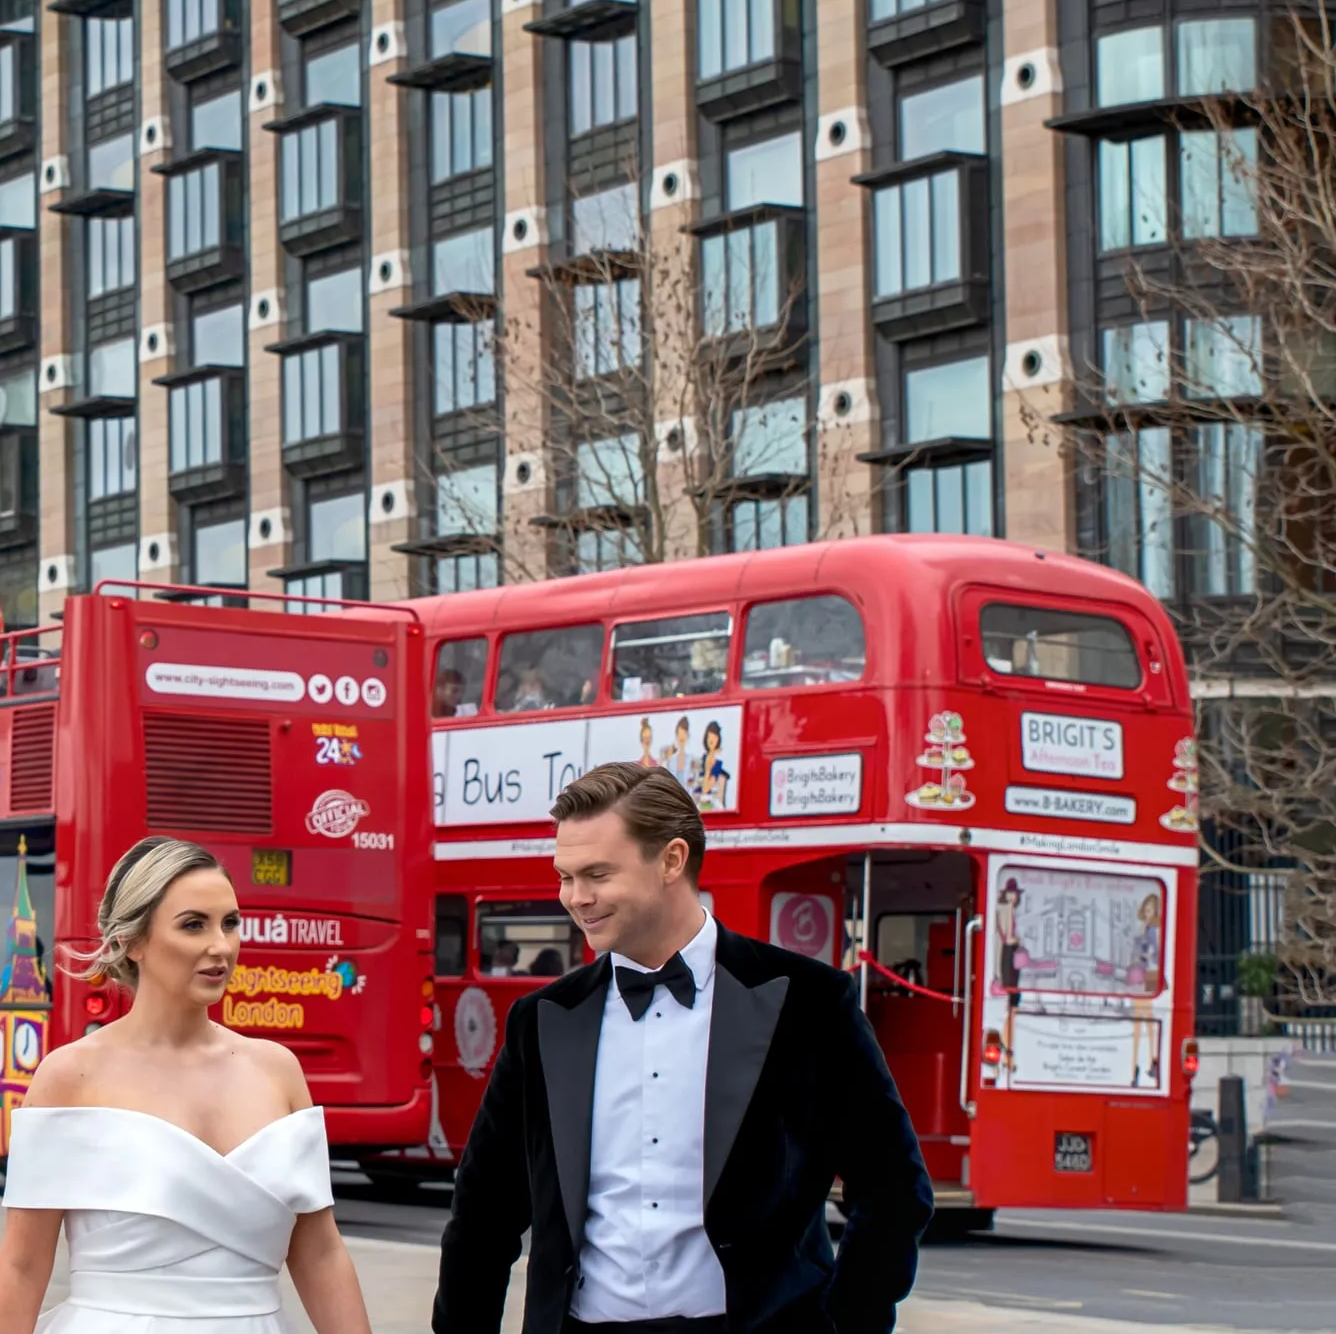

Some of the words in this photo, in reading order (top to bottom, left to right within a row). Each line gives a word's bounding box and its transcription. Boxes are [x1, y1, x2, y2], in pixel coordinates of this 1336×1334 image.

[154, 671, 296, 692] www.city-sightseeing.com
[315, 736, 341, 765] 24
[1029, 748, 1091, 768] Afternoon
[462, 757, 522, 806] Bus
[542, 750, 598, 801] To
[1013, 794, 1129, 818] www.B-BAKERY.com
[351, 831, 395, 851] 15031
[289, 918, 344, 946] TRAVEL
[222, 994, 305, 1029] London
